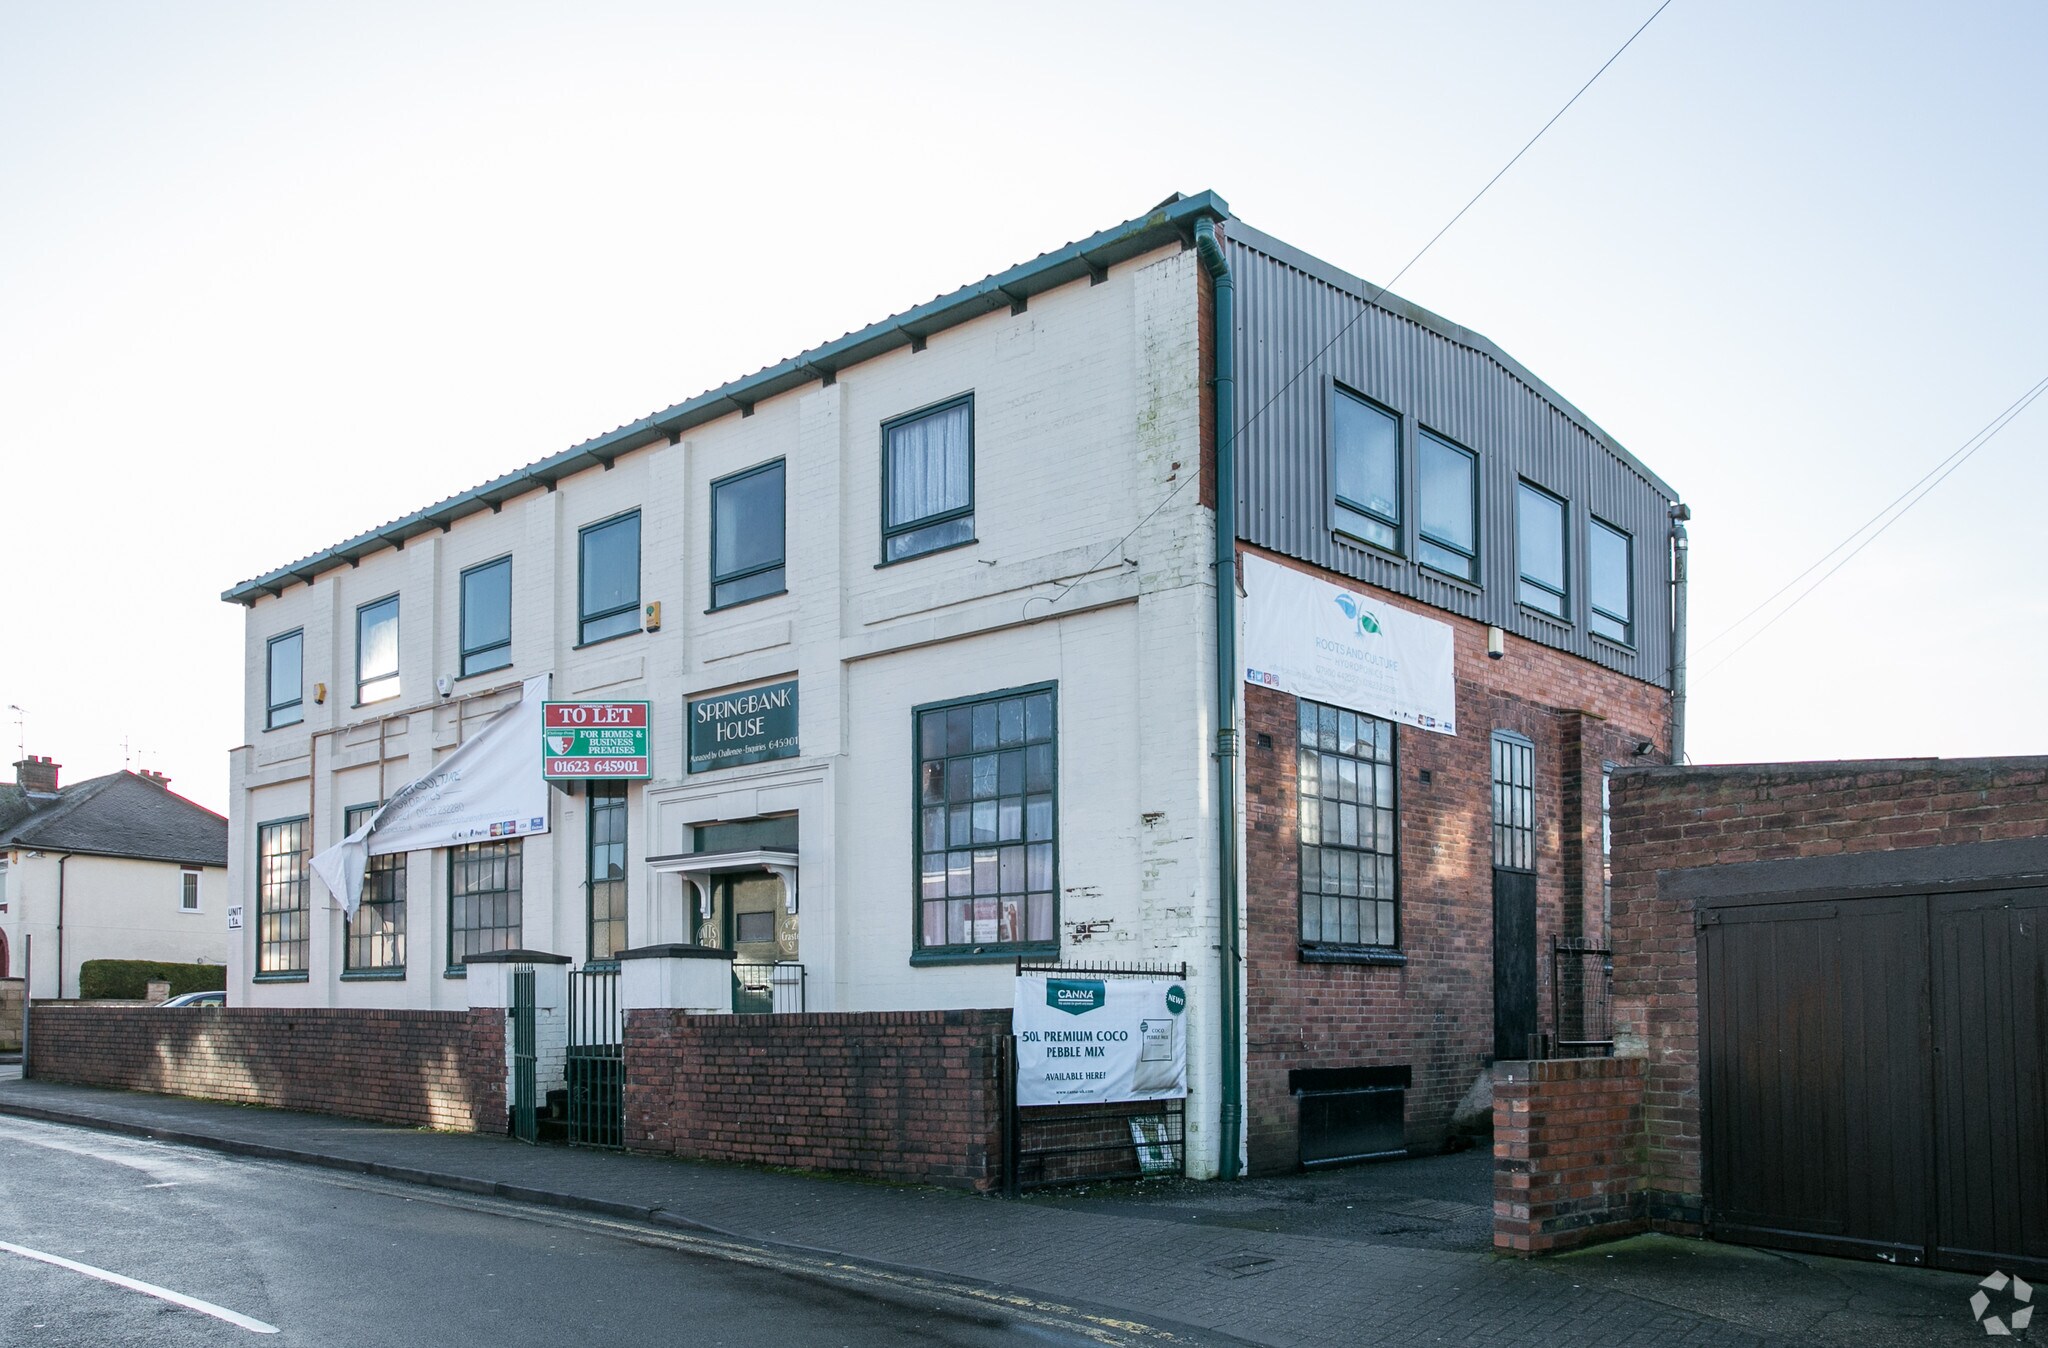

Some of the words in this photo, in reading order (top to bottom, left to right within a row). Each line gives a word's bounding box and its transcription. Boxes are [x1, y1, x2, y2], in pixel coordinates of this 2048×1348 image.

[1315, 637, 1345, 655] ROOTS
[1346, 647, 1364, 661] AND
[1364, 652, 1399, 672] CULTURE
[697, 687, 792, 724] SPRINGBANK
[559, 708, 587, 723] TO
[592, 708, 633, 723] LET
[580, 730, 599, 738] FOR
[601, 730, 634, 738] HOMES
[636, 730, 643, 738] &
[717, 716, 765, 742] HOUSE
[589, 738, 634, 746] BUSINESS
[768, 736, 799, 750] 645901
[588, 746, 636, 754] PREMISES
[554, 761, 590, 772] 01623
[594, 761, 639, 772] 645901
[228, 907, 242, 916] UNIT
[1058, 989, 1094, 999] CANNA
[1022, 1031, 1041, 1042] 50L
[1044, 1031, 1093, 1042] PREMIUM
[1096, 1030, 1129, 1042] COCO
[1046, 1046, 1082, 1058] PEBBLE
[1084, 1046, 1105, 1057] MIX
[1045, 1072, 1084, 1081] AVAILABLE
[1085, 1071, 1106, 1080] HERE!
